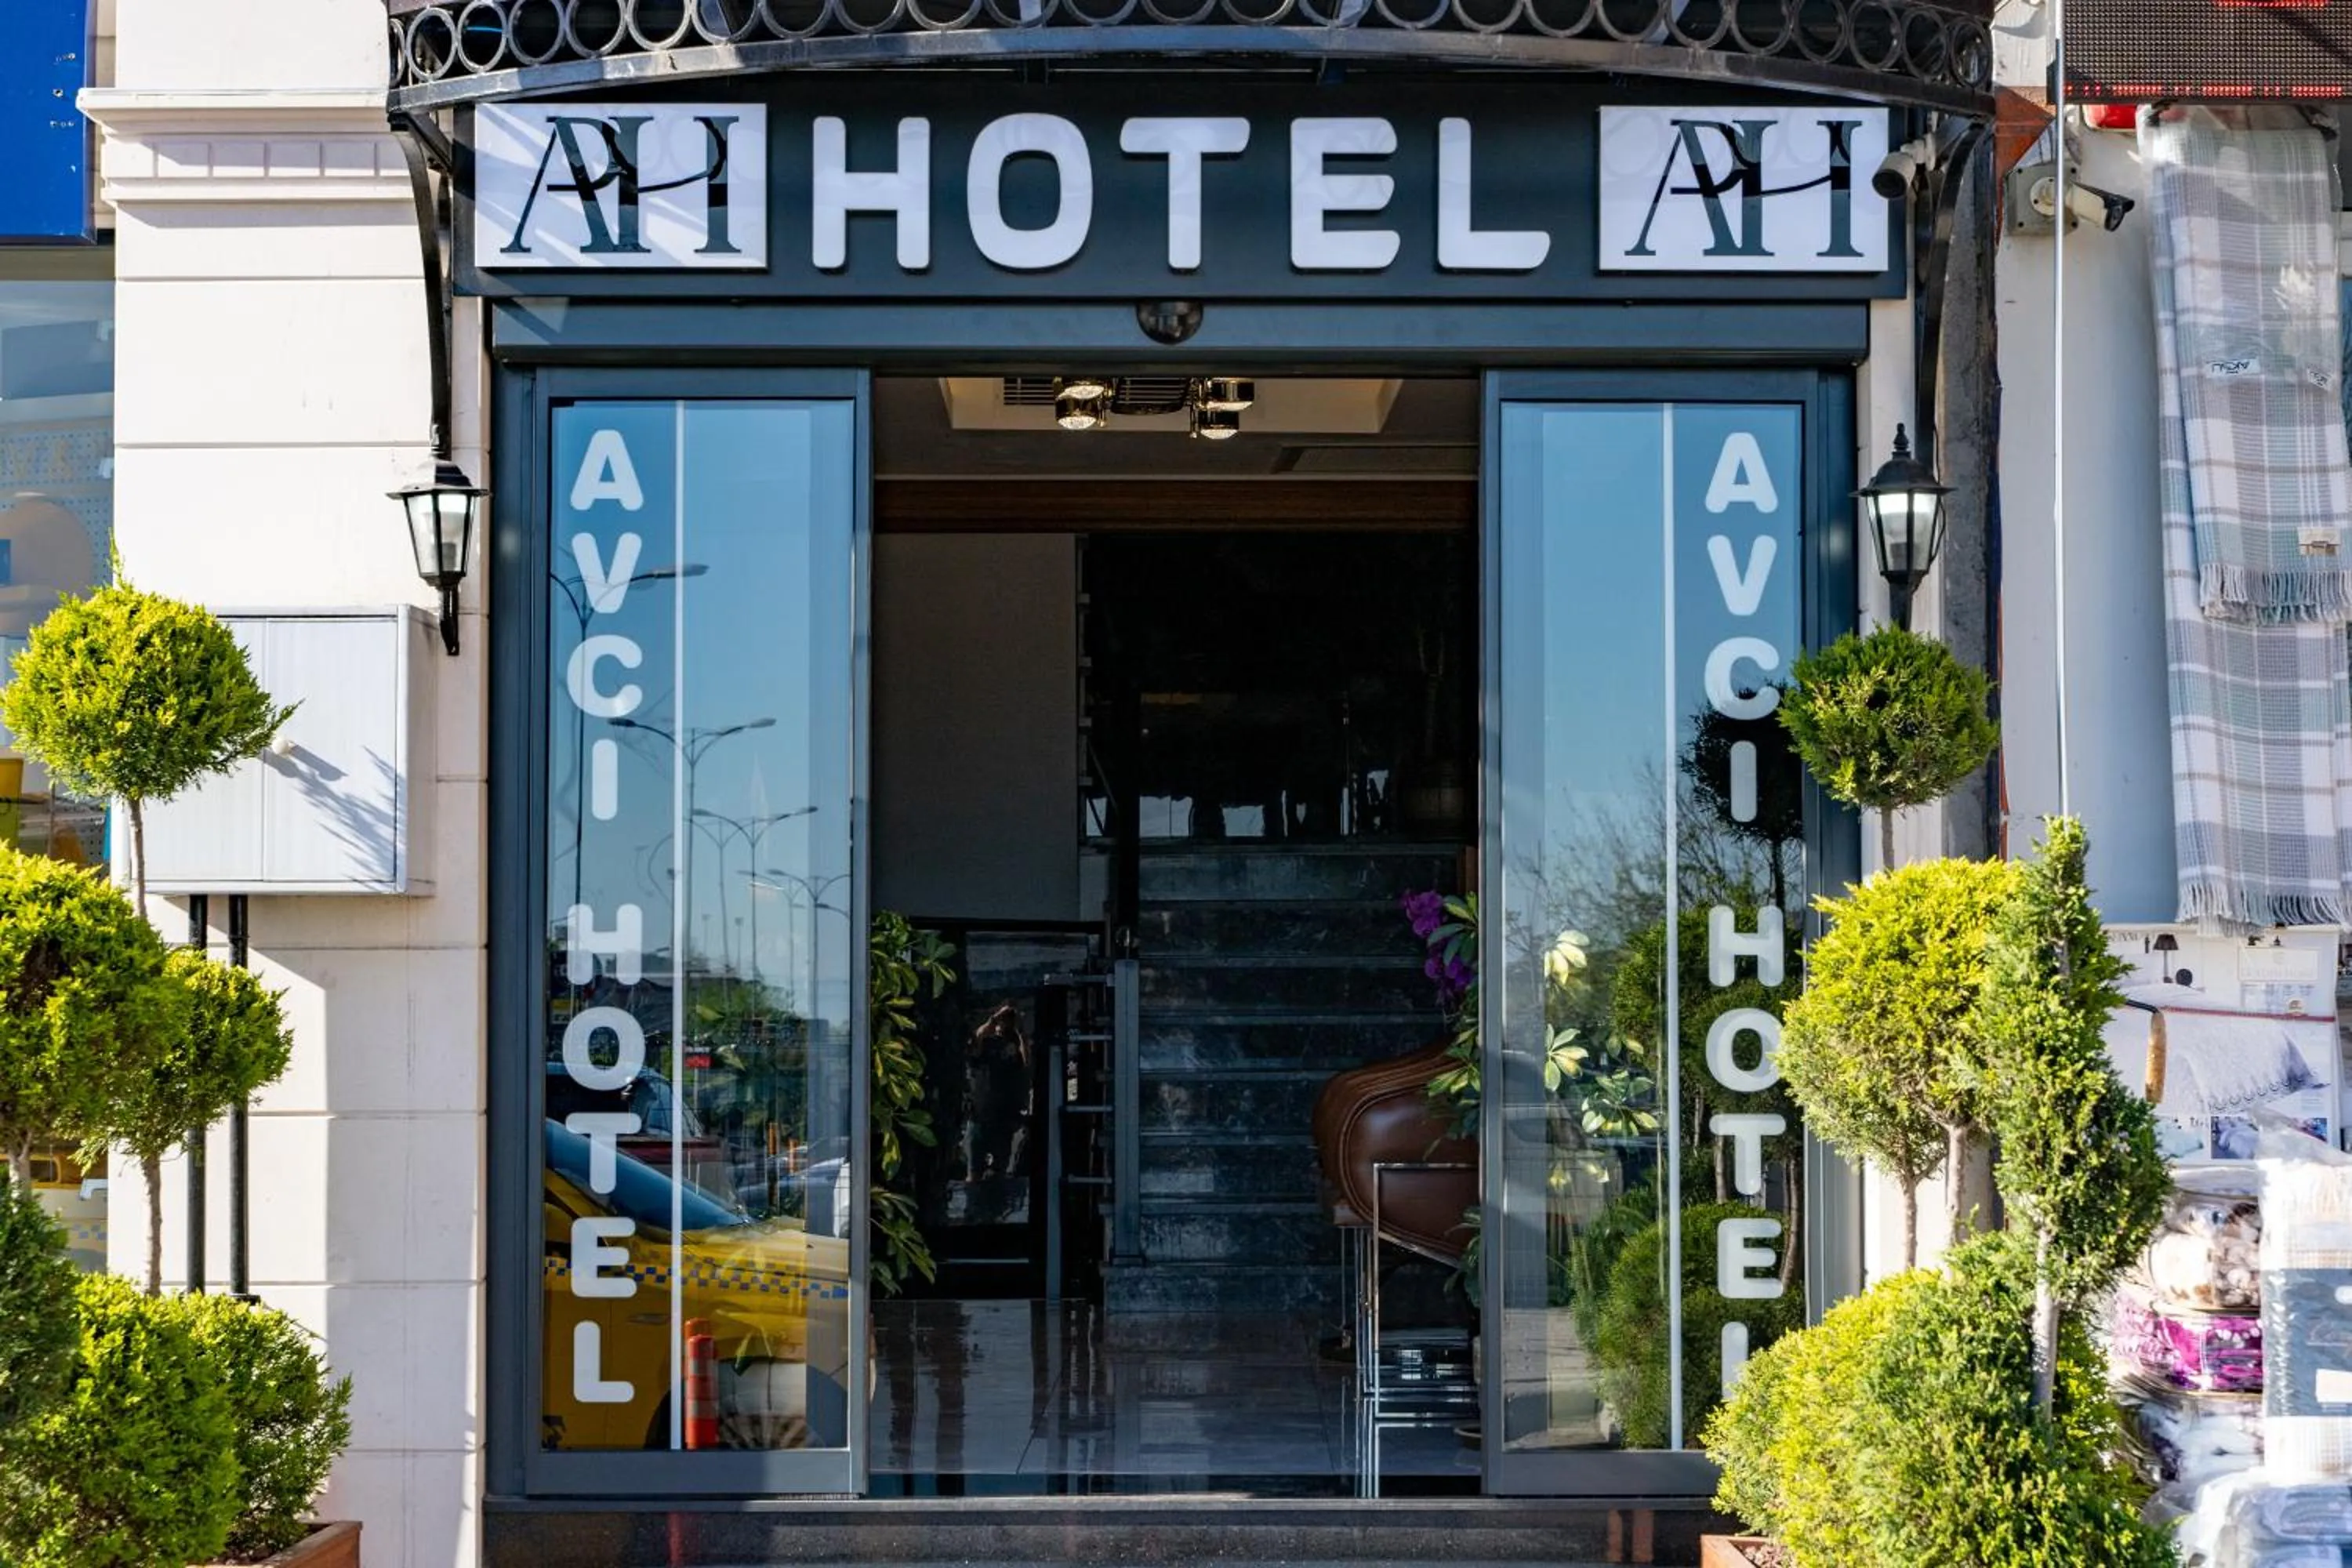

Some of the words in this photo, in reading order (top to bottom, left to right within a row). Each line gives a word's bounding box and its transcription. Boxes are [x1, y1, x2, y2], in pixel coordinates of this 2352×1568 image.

[811, 114, 1551, 270] HOTEL
[566, 429, 644, 822] AVCI
[1704, 431, 1781, 823] AVCI
[561, 902, 647, 1403] HOTEL
